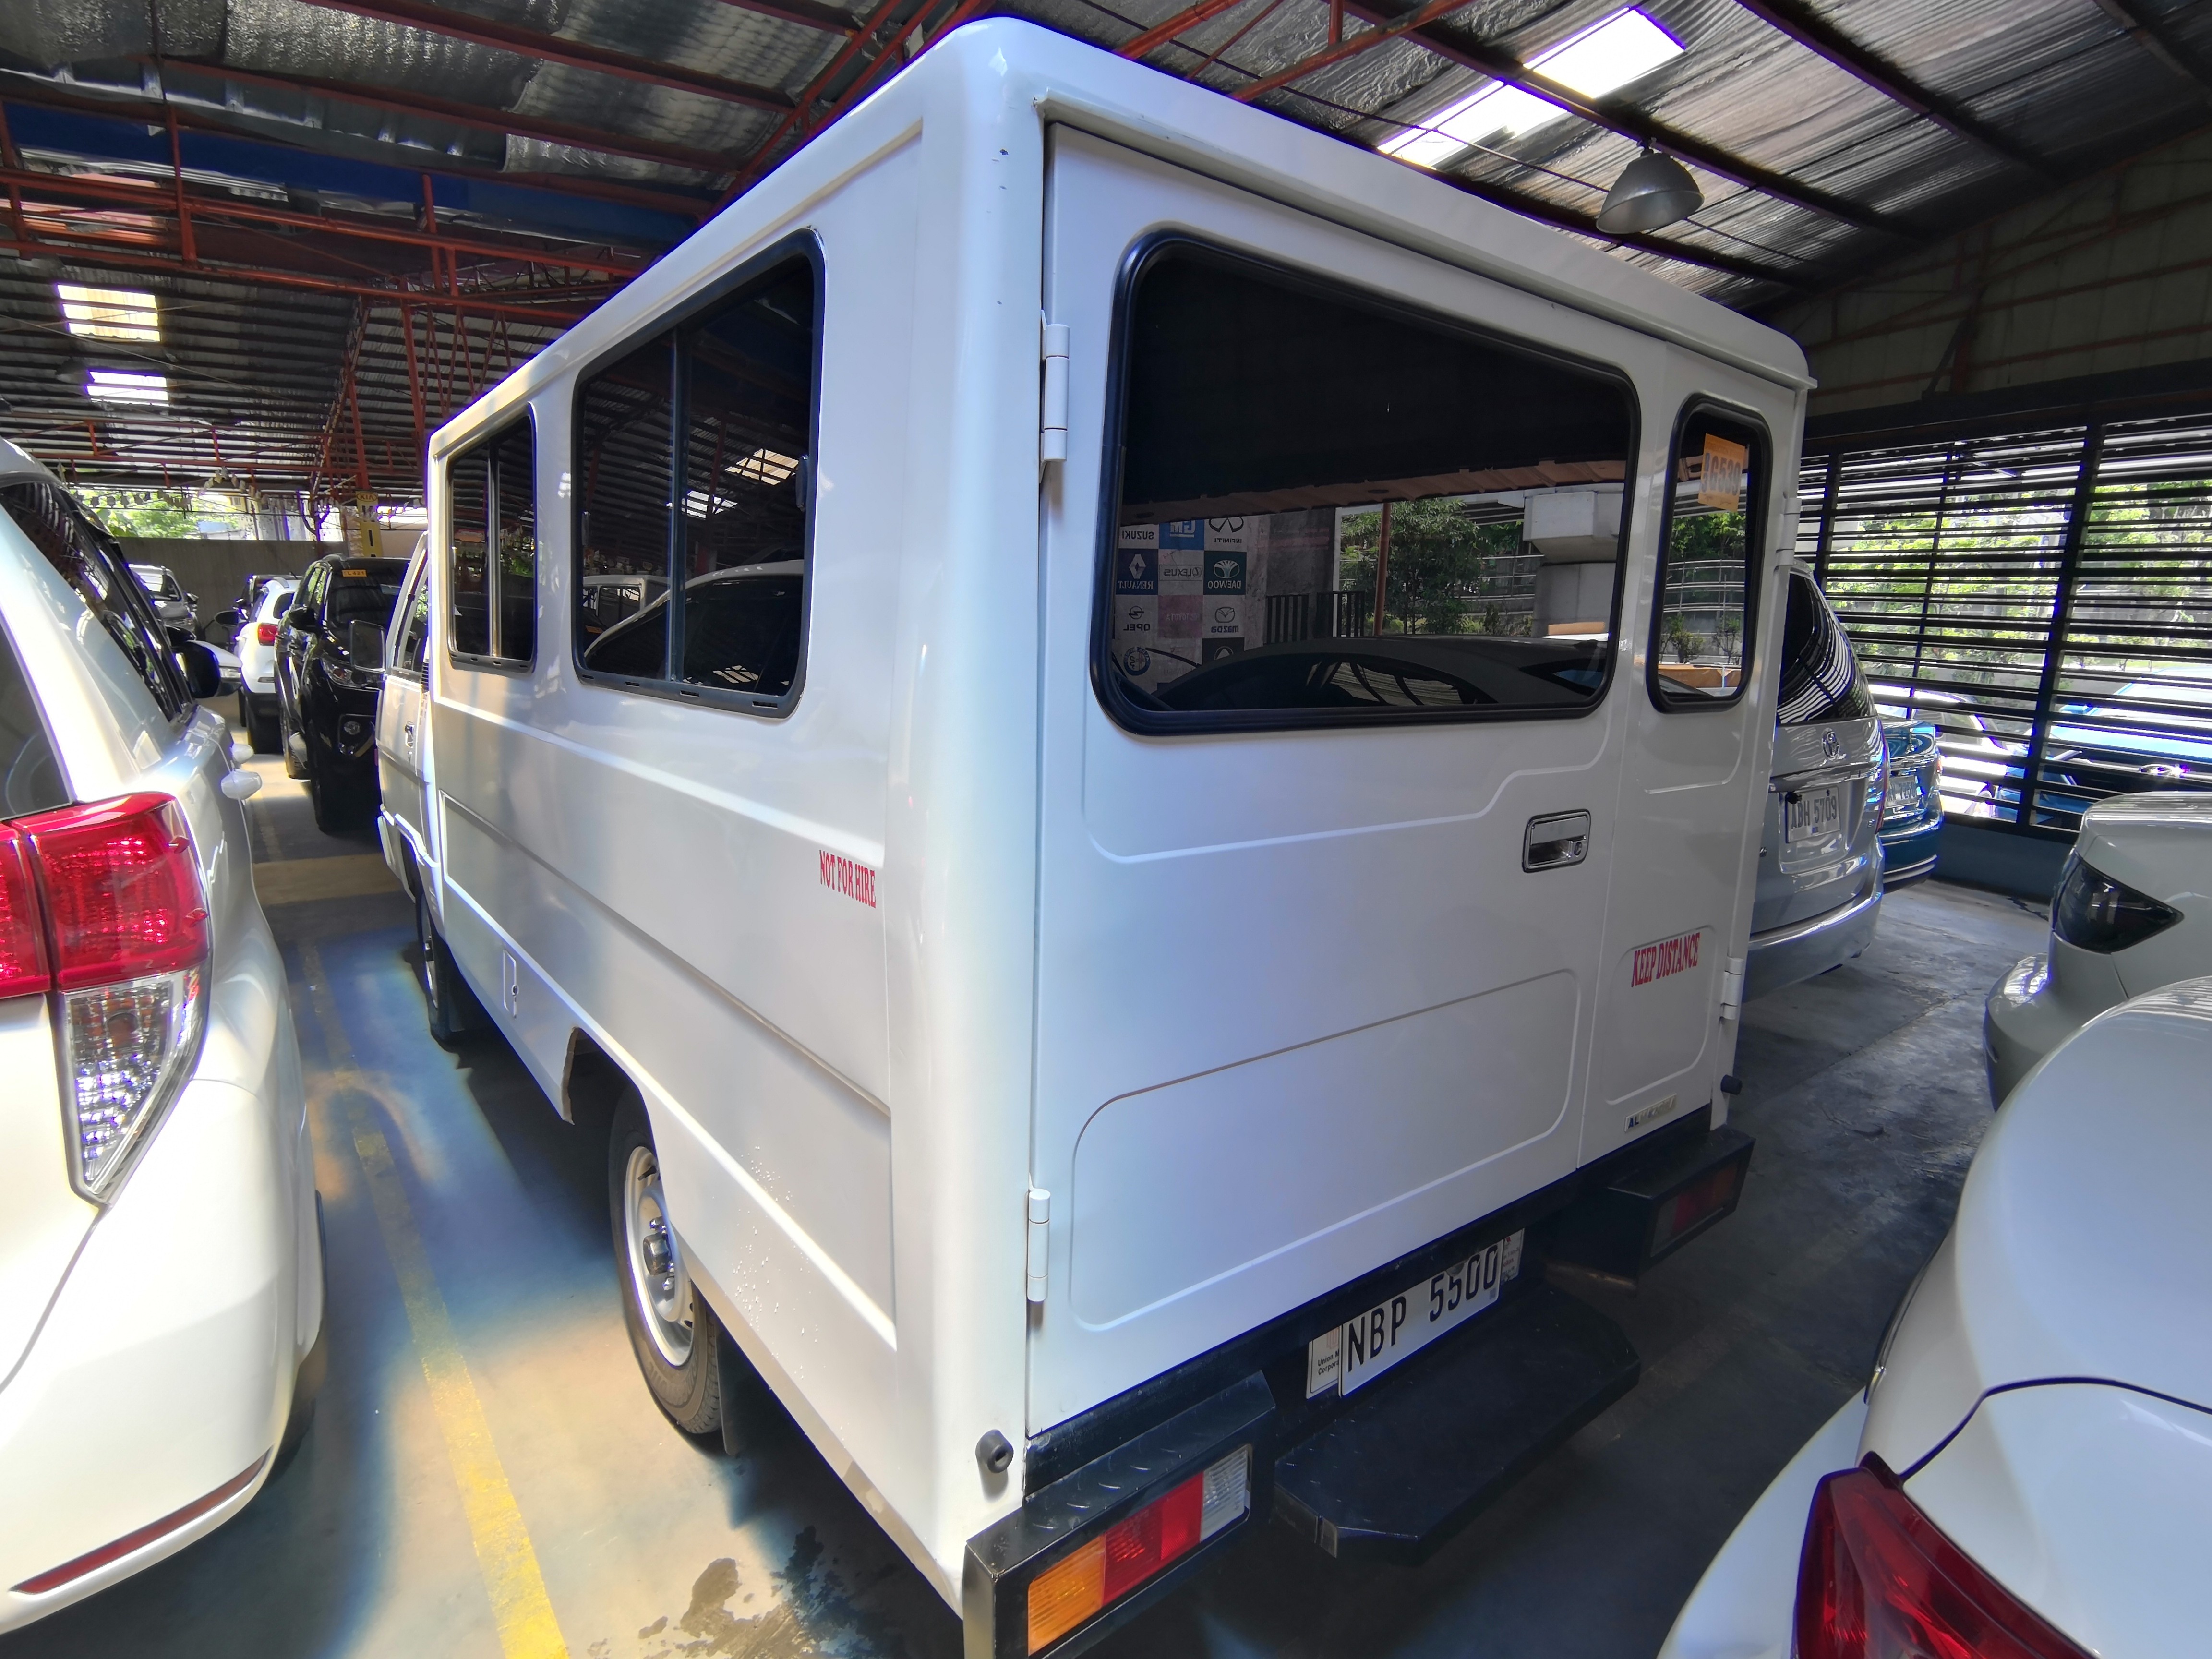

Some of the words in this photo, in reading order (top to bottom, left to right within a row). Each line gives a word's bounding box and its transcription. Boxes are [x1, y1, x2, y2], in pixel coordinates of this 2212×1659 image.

[1814, 796, 1837, 824] 5709
[819, 849, 836, 890] NOT
[837, 856, 854, 899] FOR
[854, 863, 876, 909] HIRE
[1631, 945, 1657, 988] KEEP
[1656, 932, 1700, 979] DISTANCE
[1347, 1296, 1407, 1373] NBP
[1429, 1245, 1499, 1323] 5500
[1318, 1354, 1334, 1367] Union
[1318, 1359, 1339, 1375] Corpora
